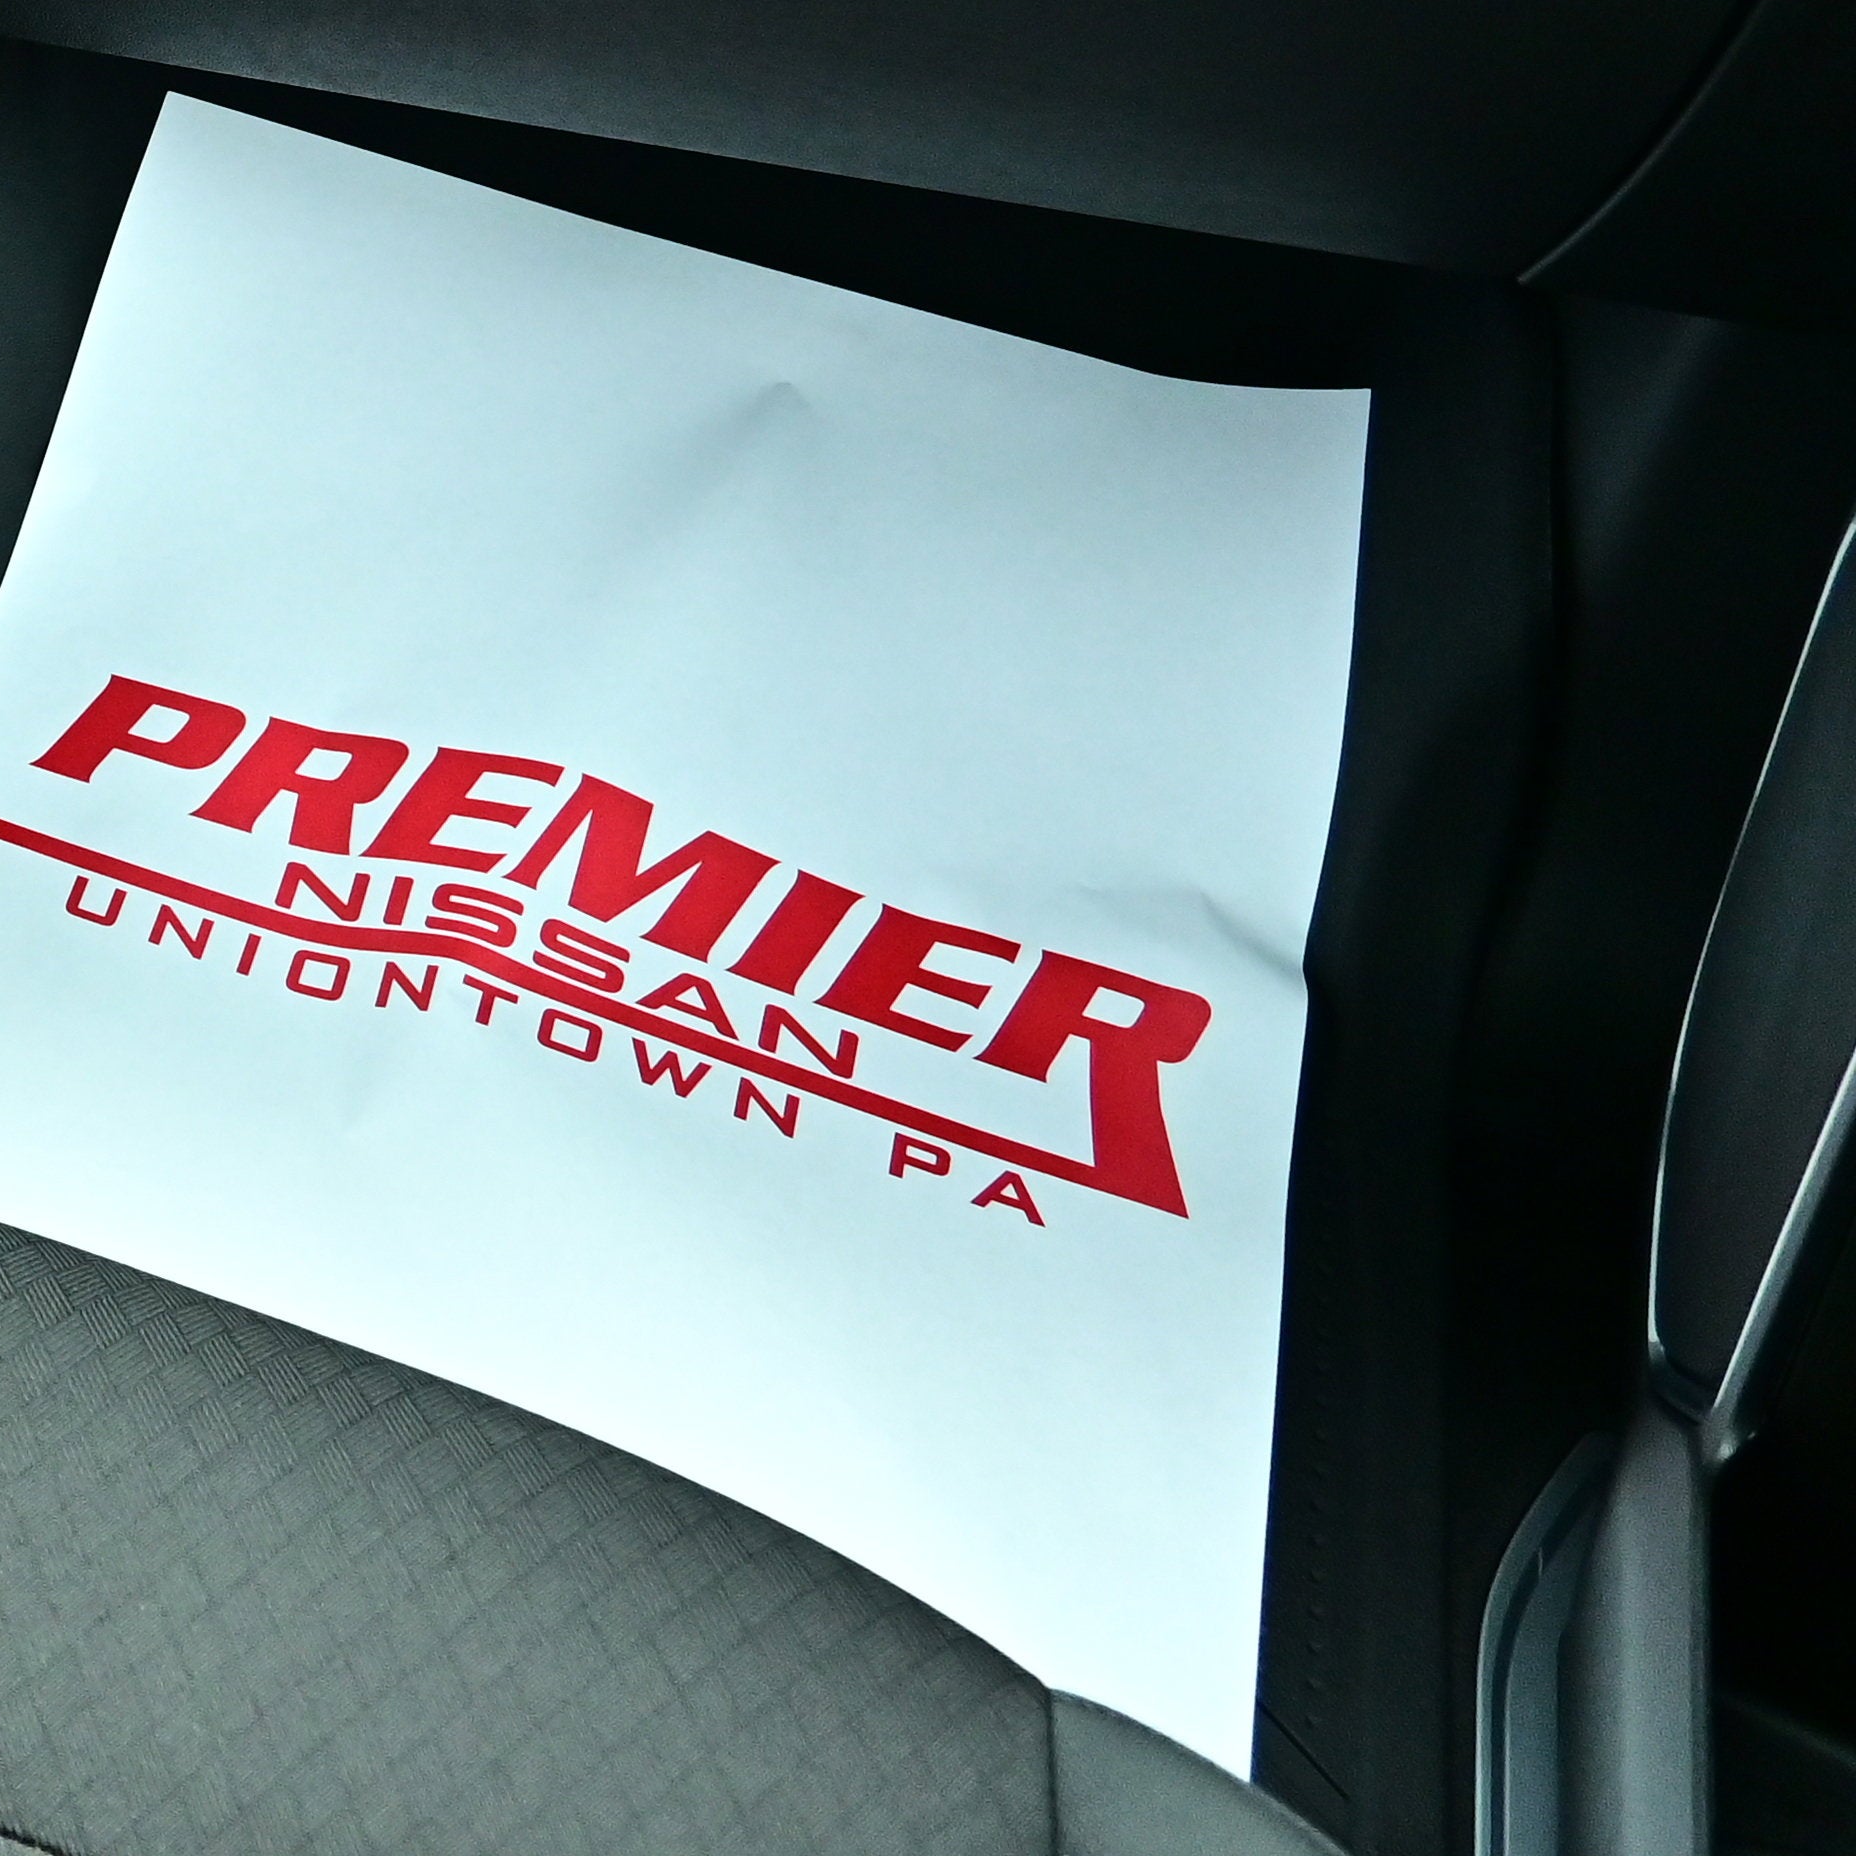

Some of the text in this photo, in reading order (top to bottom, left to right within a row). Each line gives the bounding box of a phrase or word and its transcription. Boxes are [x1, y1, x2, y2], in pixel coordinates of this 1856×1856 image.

[30, 674, 1213, 1220] PREMIER
[64, 875, 1046, 1227] UNIONTOWN PA
[275, 862, 859, 1080] NISSAN
